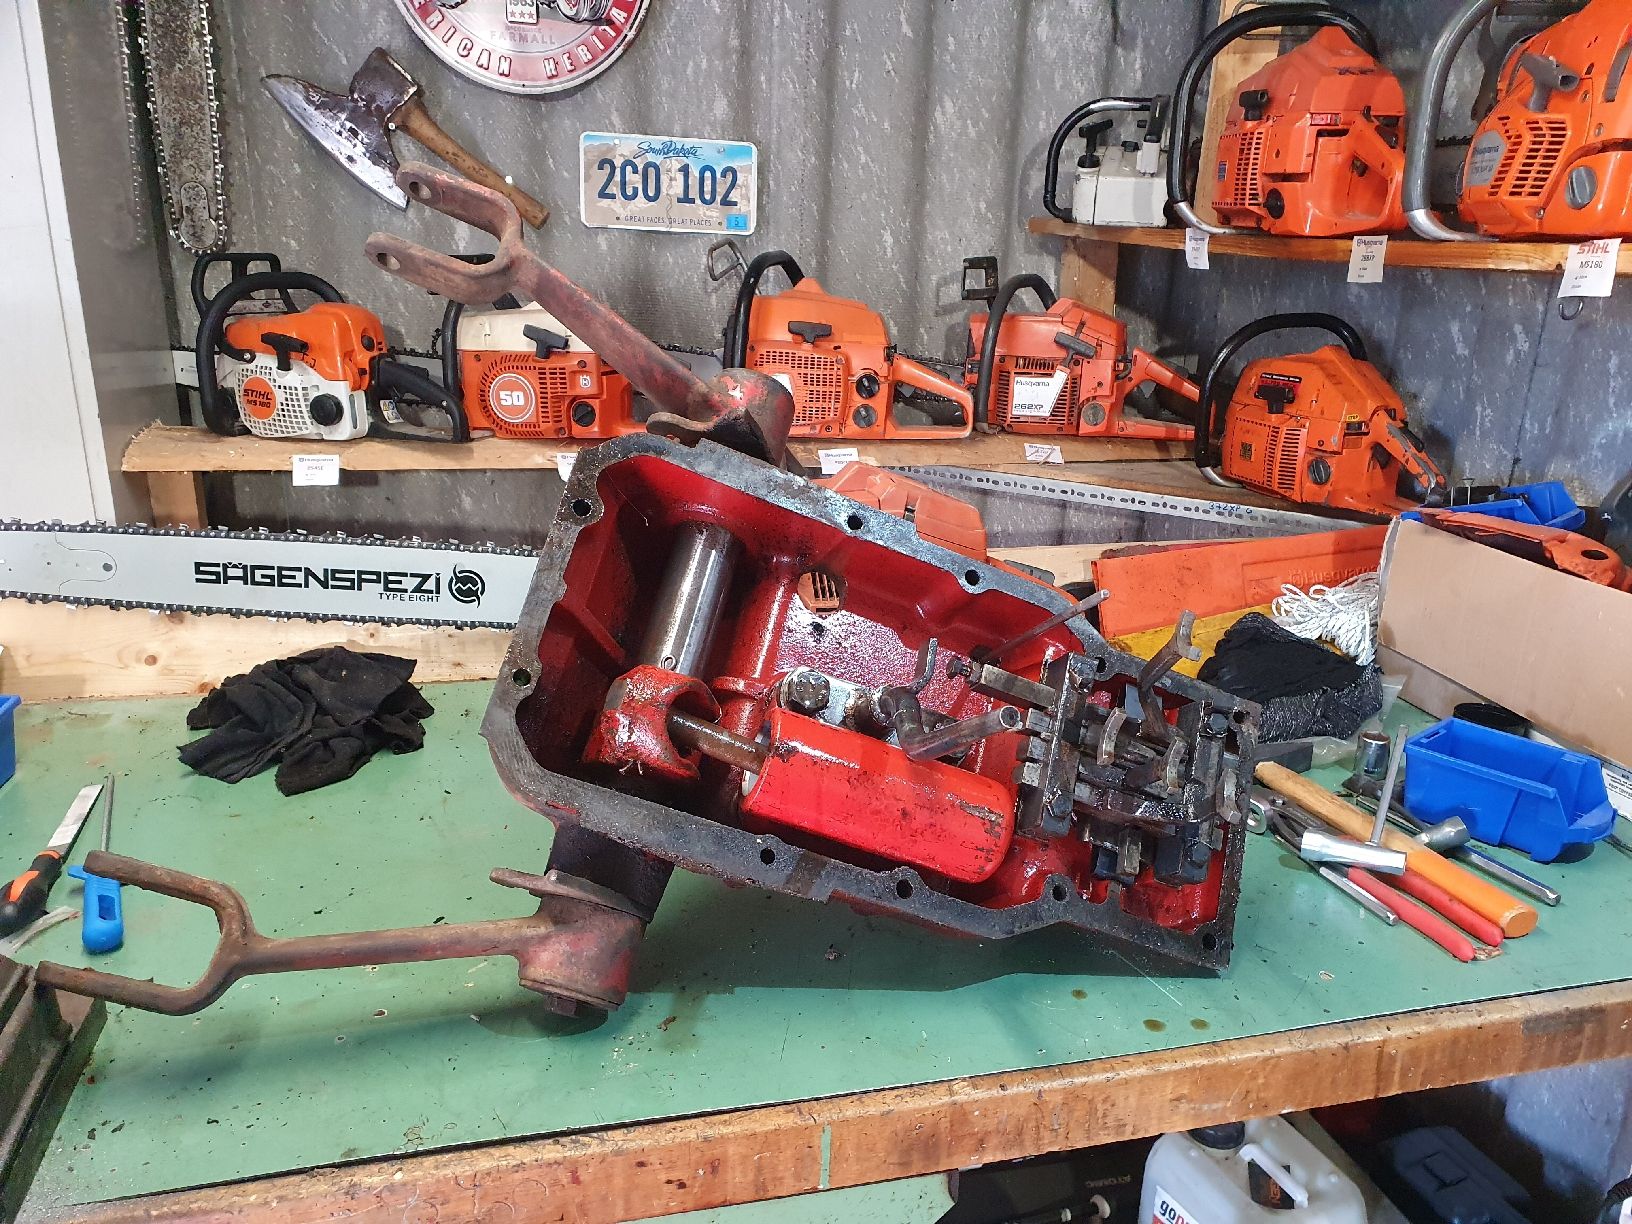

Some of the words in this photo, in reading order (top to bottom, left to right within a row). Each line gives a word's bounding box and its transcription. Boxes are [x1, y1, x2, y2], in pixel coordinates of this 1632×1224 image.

[490, 30, 556, 45] FARMALL
[542, 0, 634, 79] HERITA
[663, 140, 704, 160] Dakota
[677, 163, 738, 207] 102
[689, 218, 712, 226] PLACES
[1577, 241, 1610, 255] STIHL
[243, 388, 273, 401] STIHL
[499, 390, 525, 406] 50
[258, 400, 271, 408] 180
[1014, 403, 1044, 411] 262XP
[1209, 501, 1240, 511] 372XP
[378, 592, 406, 601] TYPE
[408, 594, 440, 603] EIGHT
